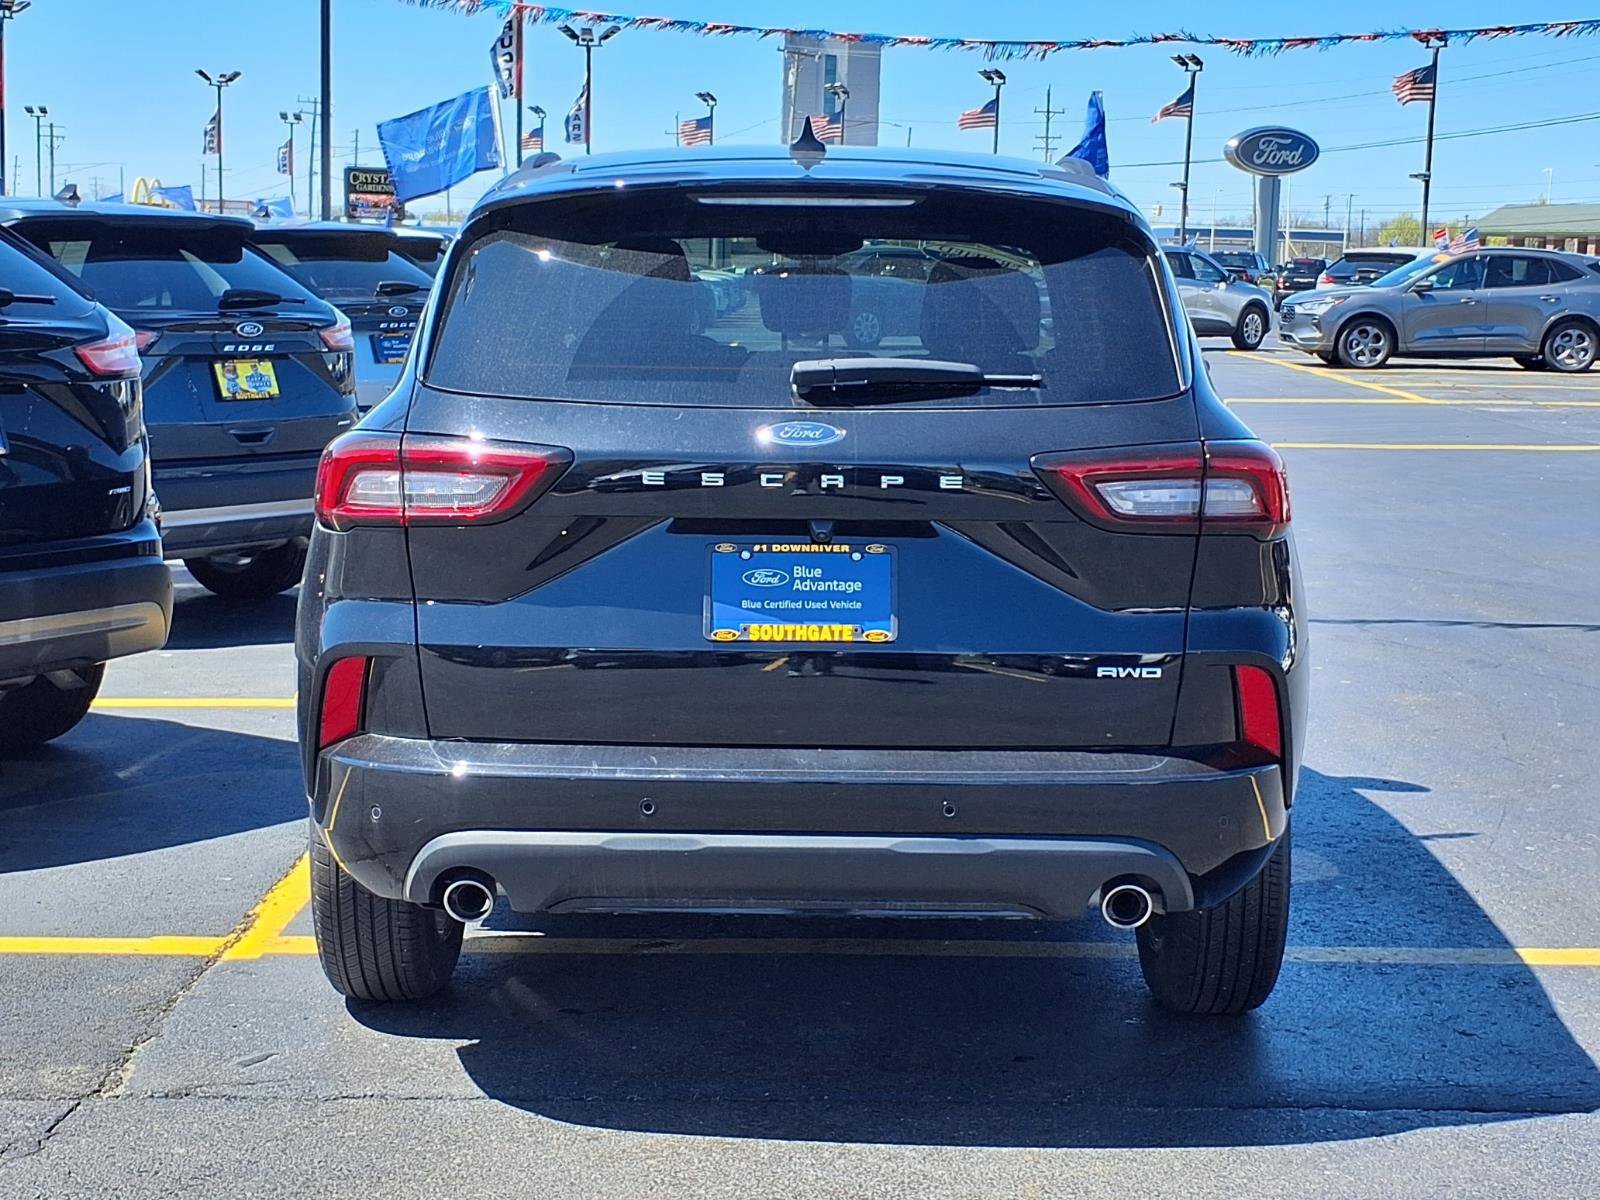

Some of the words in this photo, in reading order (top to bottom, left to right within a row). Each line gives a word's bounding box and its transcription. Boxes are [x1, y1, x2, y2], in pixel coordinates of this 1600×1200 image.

[1253, 137, 1304, 165] Ford
[223, 344, 275, 352] EDGE
[779, 423, 823, 440] Ford
[641, 470, 963, 490] ESCAPE
[753, 544, 767, 552] #1
[772, 544, 850, 553] DOWNRIVER
[751, 571, 781, 584] Ford
[793, 565, 822, 578] Blue
[793, 579, 863, 593] Advantage
[741, 600, 762, 609] Blue
[764, 600, 803, 609] Certified
[804, 600, 828, 609] Used
[830, 600, 863, 609] Vehicle
[749, 624, 854, 641] SOUTHGATE
[1096, 667, 1162, 678] AWD
